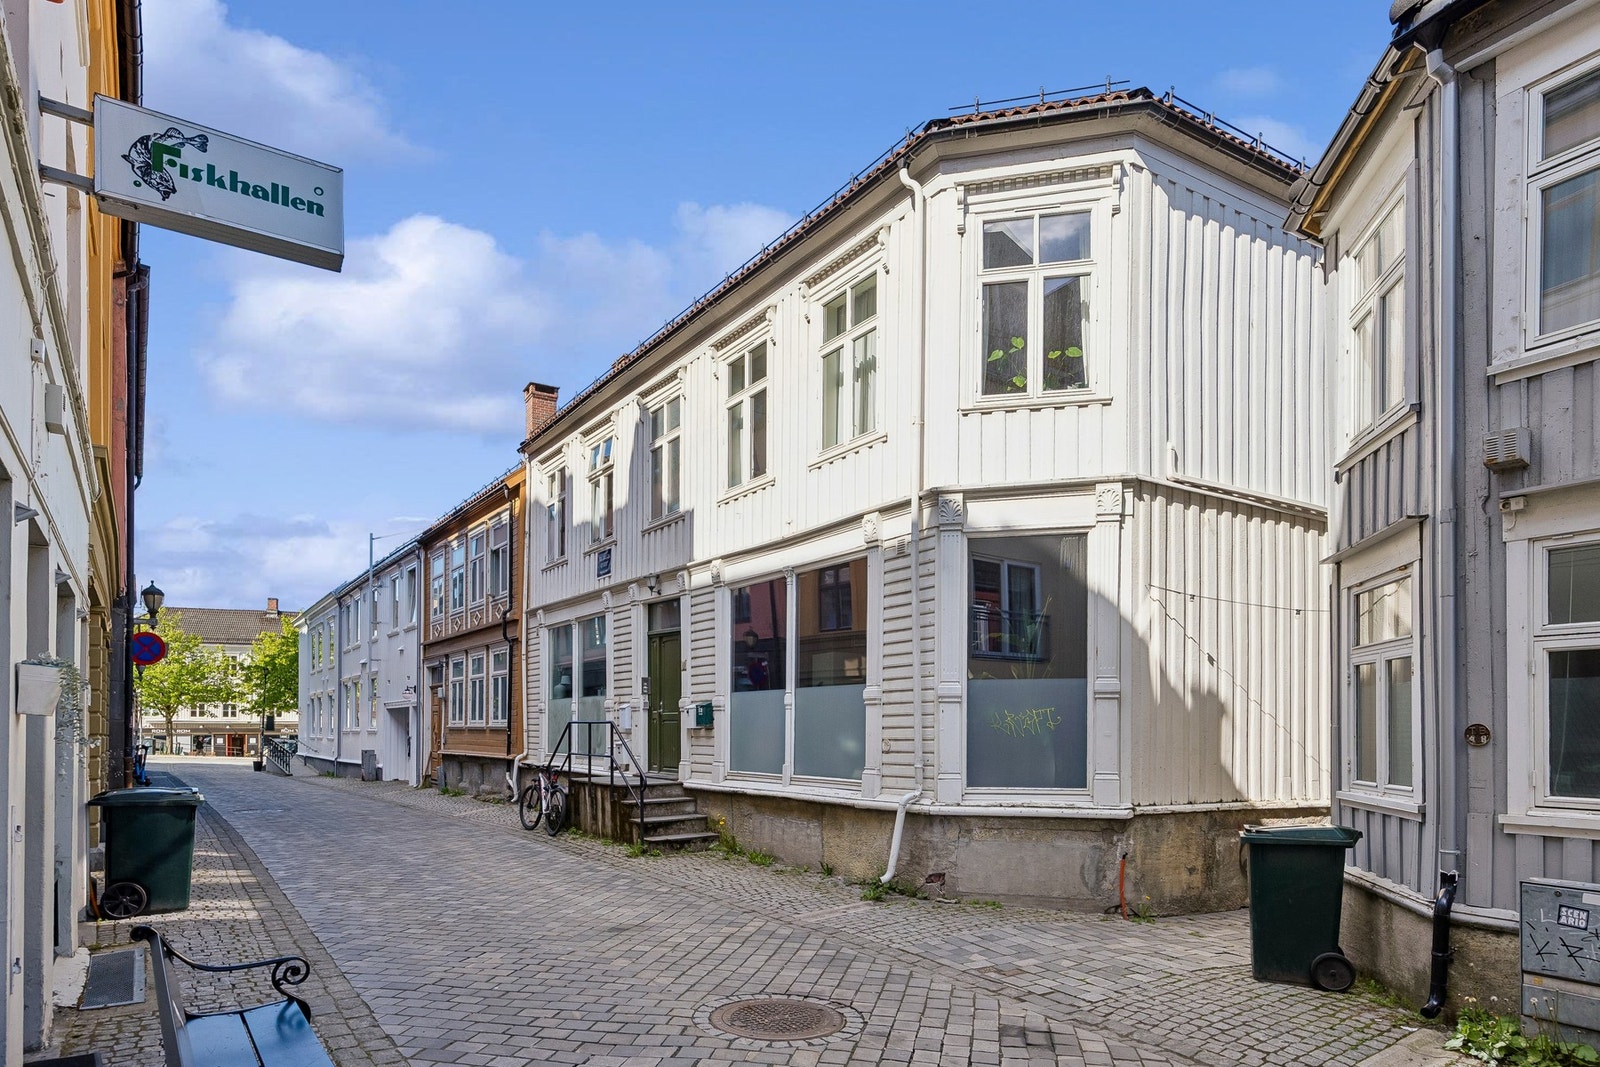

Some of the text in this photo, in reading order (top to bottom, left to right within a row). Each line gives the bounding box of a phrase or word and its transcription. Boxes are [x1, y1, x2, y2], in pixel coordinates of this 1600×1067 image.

[152, 141, 325, 217] Fiskhallen
[1561, 907, 1587, 920] SCEN
[1559, 916, 1586, 927] ARIO
